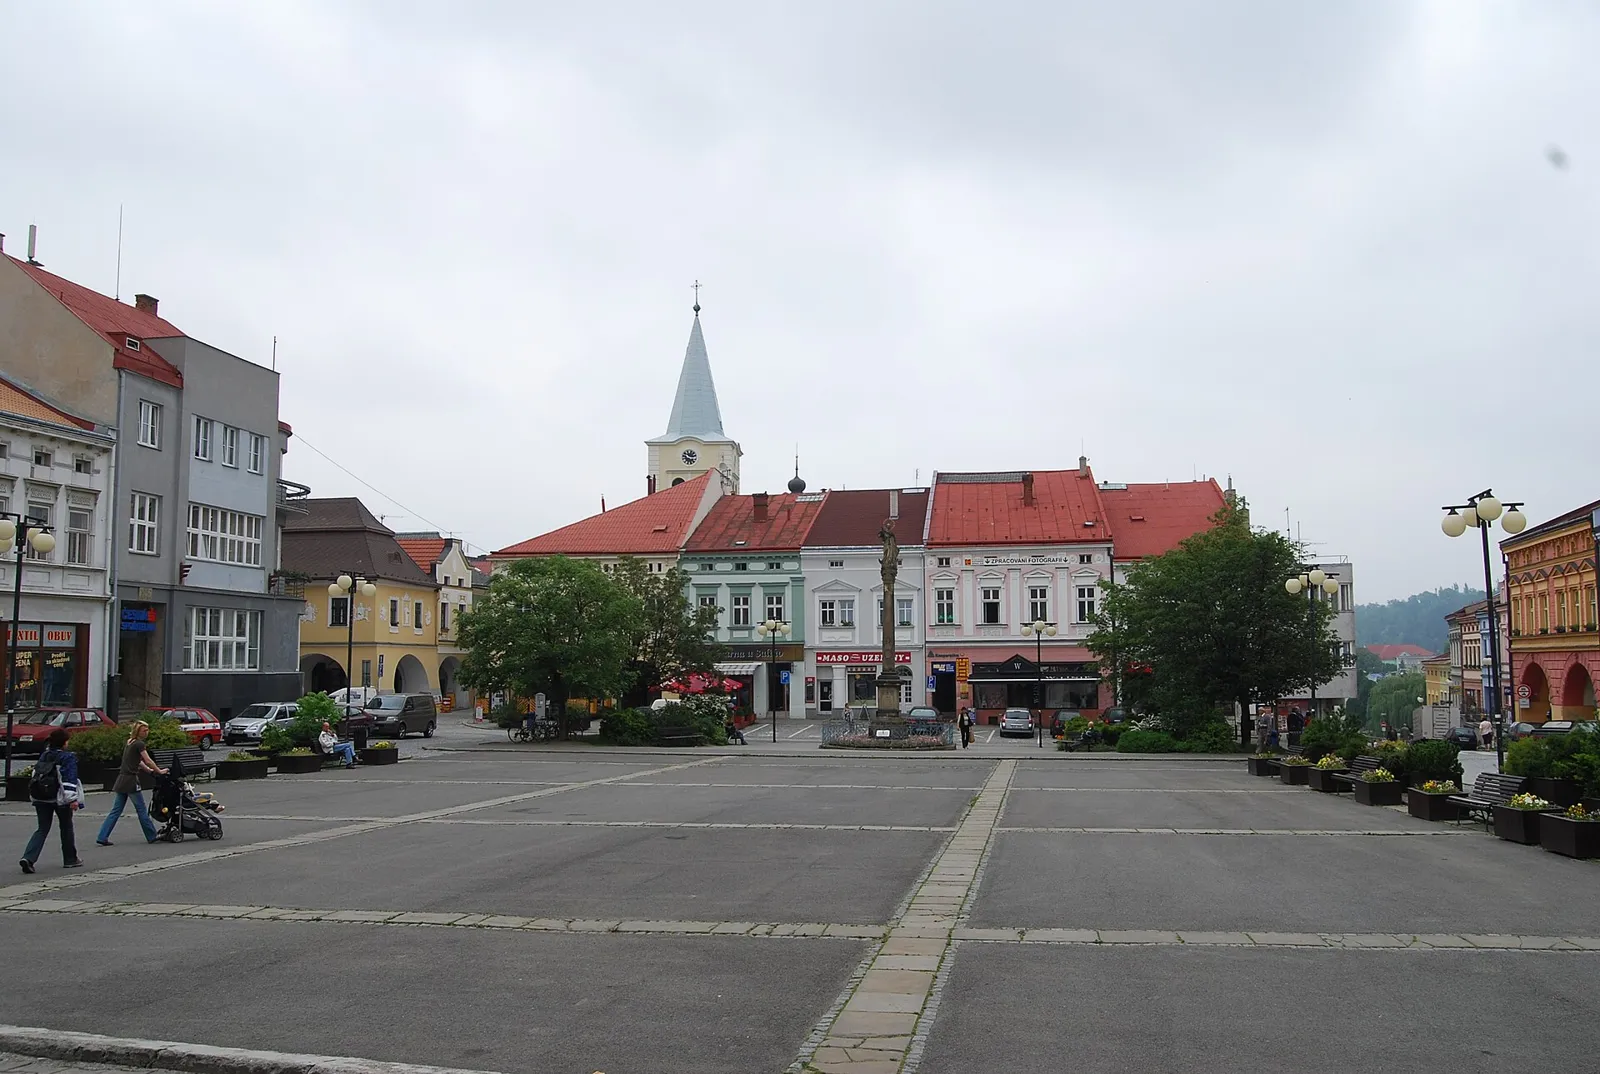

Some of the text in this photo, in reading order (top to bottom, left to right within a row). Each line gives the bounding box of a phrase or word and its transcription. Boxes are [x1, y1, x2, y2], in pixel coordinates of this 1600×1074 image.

[7, 630, 39, 641] TXTIL
[47, 630, 72, 641] OBUV
[15, 651, 33, 660] UPER
[822, 654, 850, 662] MASO
[861, 654, 905, 662] UZEY
[1013, 662, 1022, 670] W
